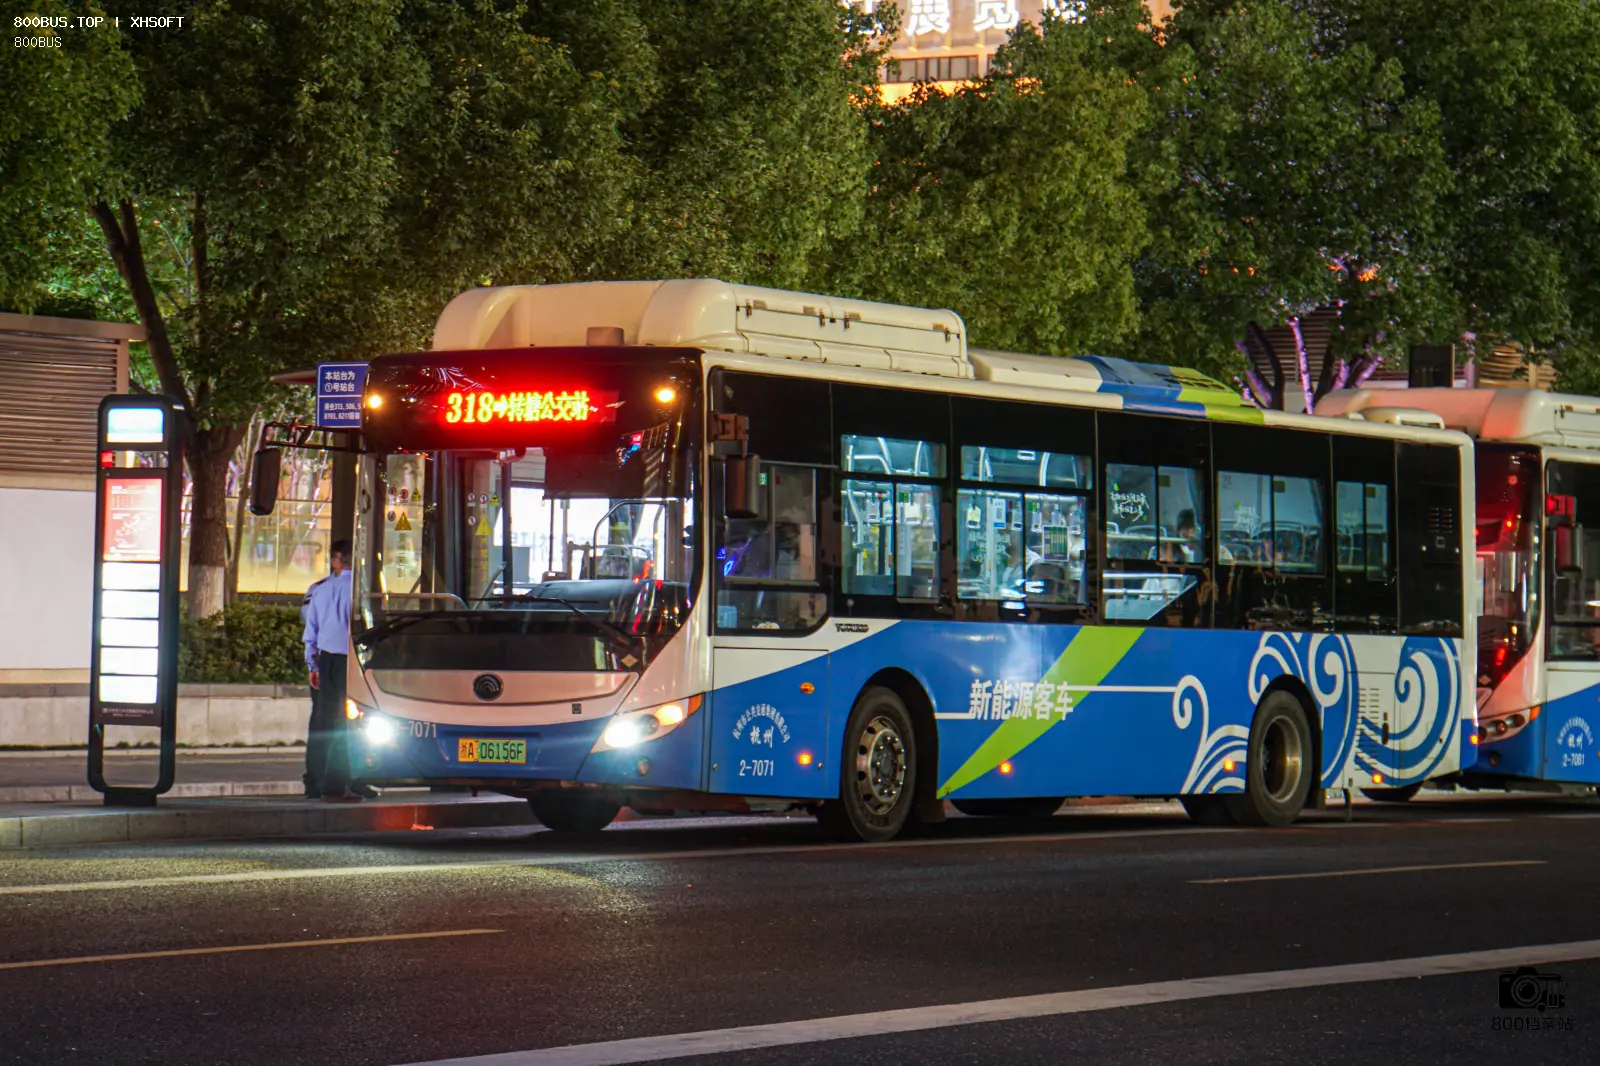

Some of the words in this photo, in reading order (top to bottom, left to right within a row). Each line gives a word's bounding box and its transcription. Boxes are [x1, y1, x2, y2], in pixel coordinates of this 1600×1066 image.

[325, 371, 355, 380] 本站台为
[446, 392, 494, 423] 318
[507, 391, 590, 422] 转塘公交站
[968, 679, 1074, 720] 新能源客车
[749, 725, 774, 748] 杭州
[739, 759, 774, 776] 2-7071
